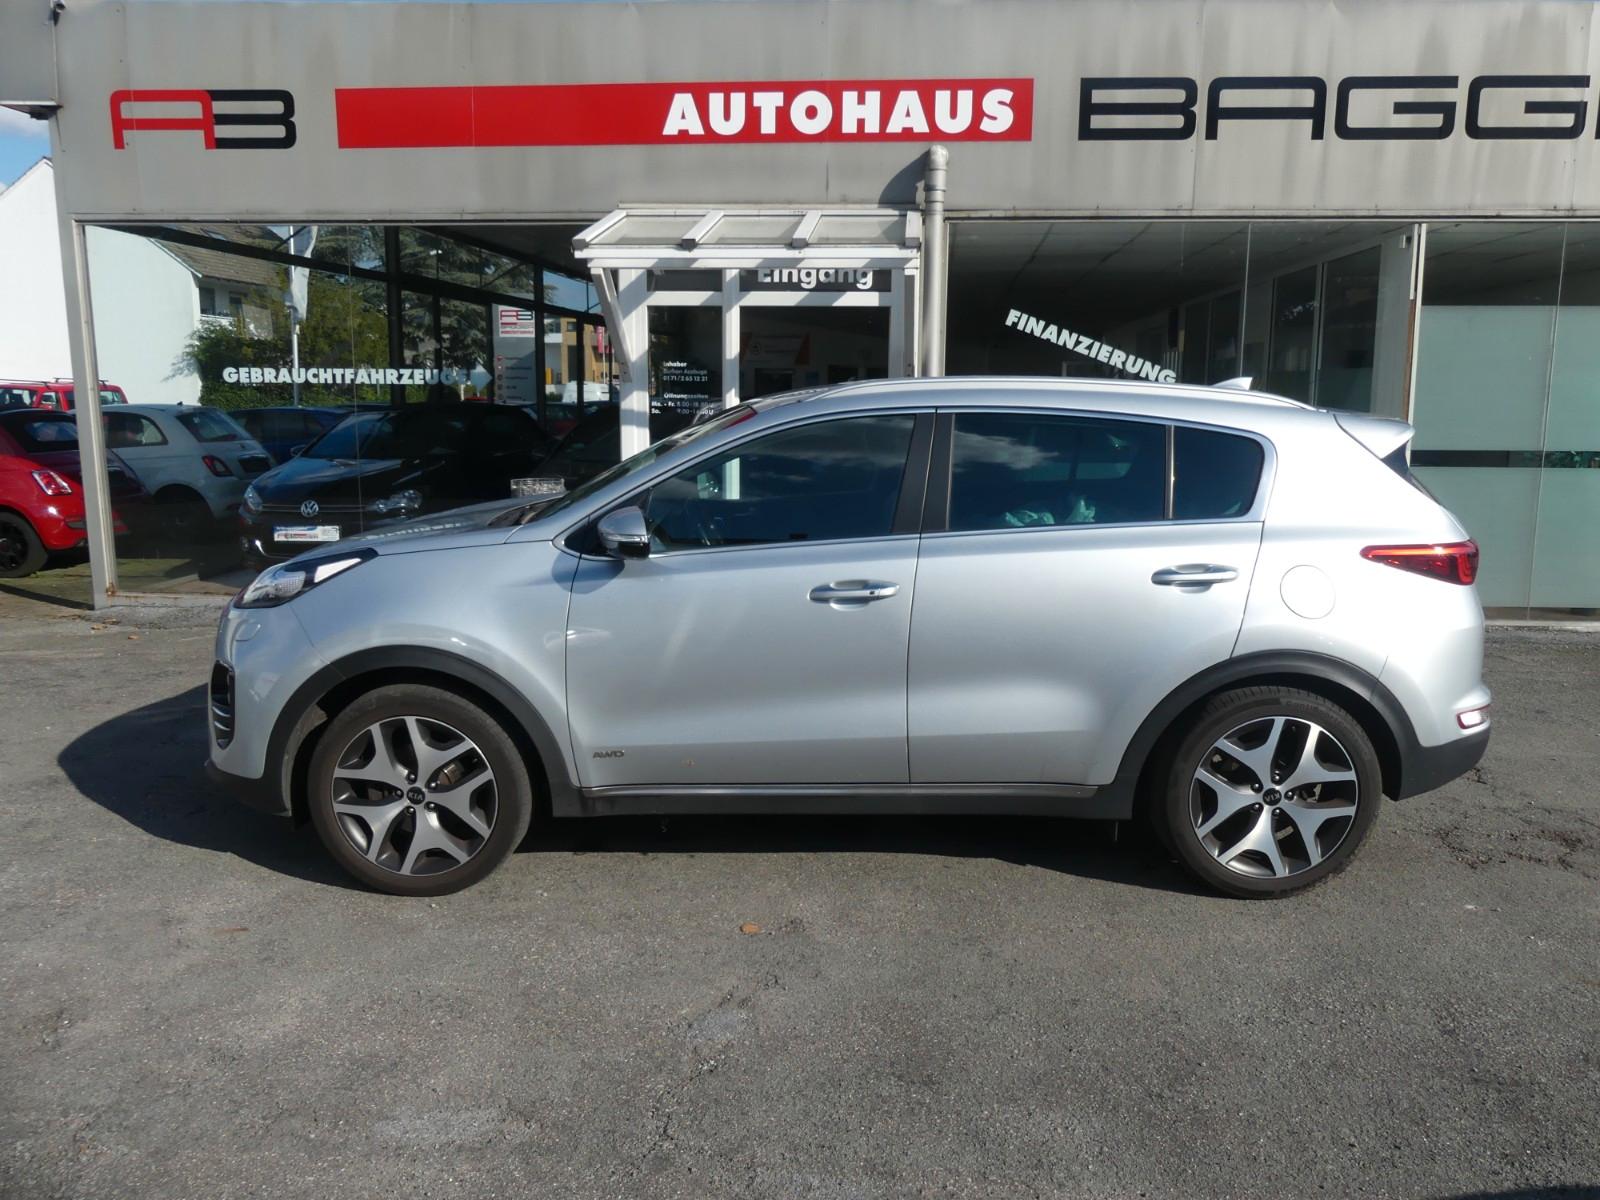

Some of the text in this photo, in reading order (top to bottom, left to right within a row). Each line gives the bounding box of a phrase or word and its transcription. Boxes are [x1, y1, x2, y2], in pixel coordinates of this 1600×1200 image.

[110, 90, 297, 150] AB
[662, 89, 1014, 136] AUTOHAUS
[1078, 75, 1600, 141] BAGG
[757, 268, 873, 290] Eingang
[1005, 308, 1176, 383] FINANZIERUNG
[222, 366, 468, 385] GEBRAUCHTFAHRZEUGE
[592, 750, 625, 759] AWD
